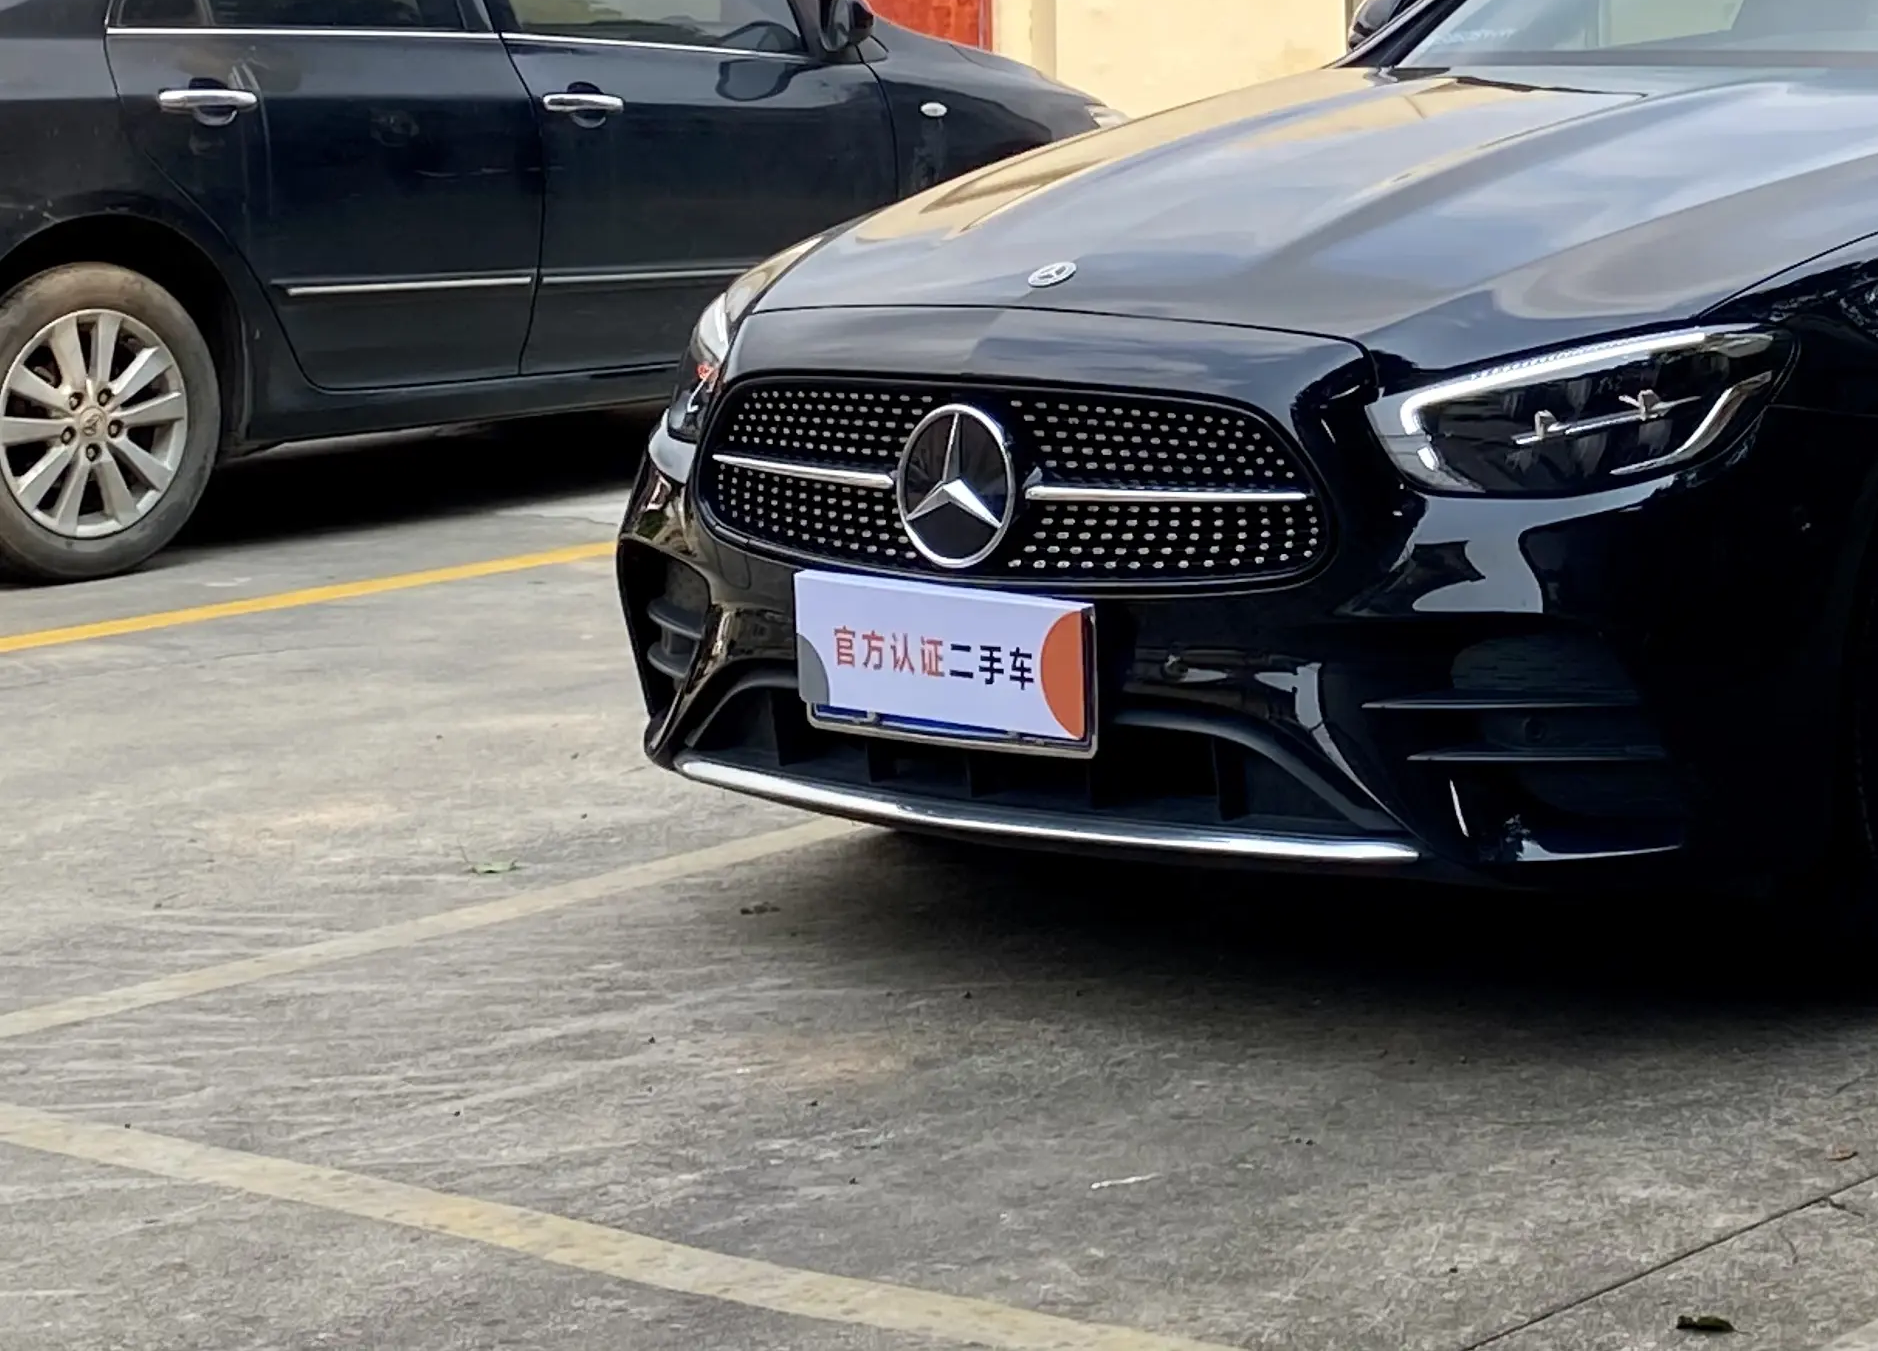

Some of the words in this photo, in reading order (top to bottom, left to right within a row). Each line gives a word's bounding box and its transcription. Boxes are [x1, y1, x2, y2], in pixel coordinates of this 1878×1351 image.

[833, 625, 1035, 691] 官方认证二手车
